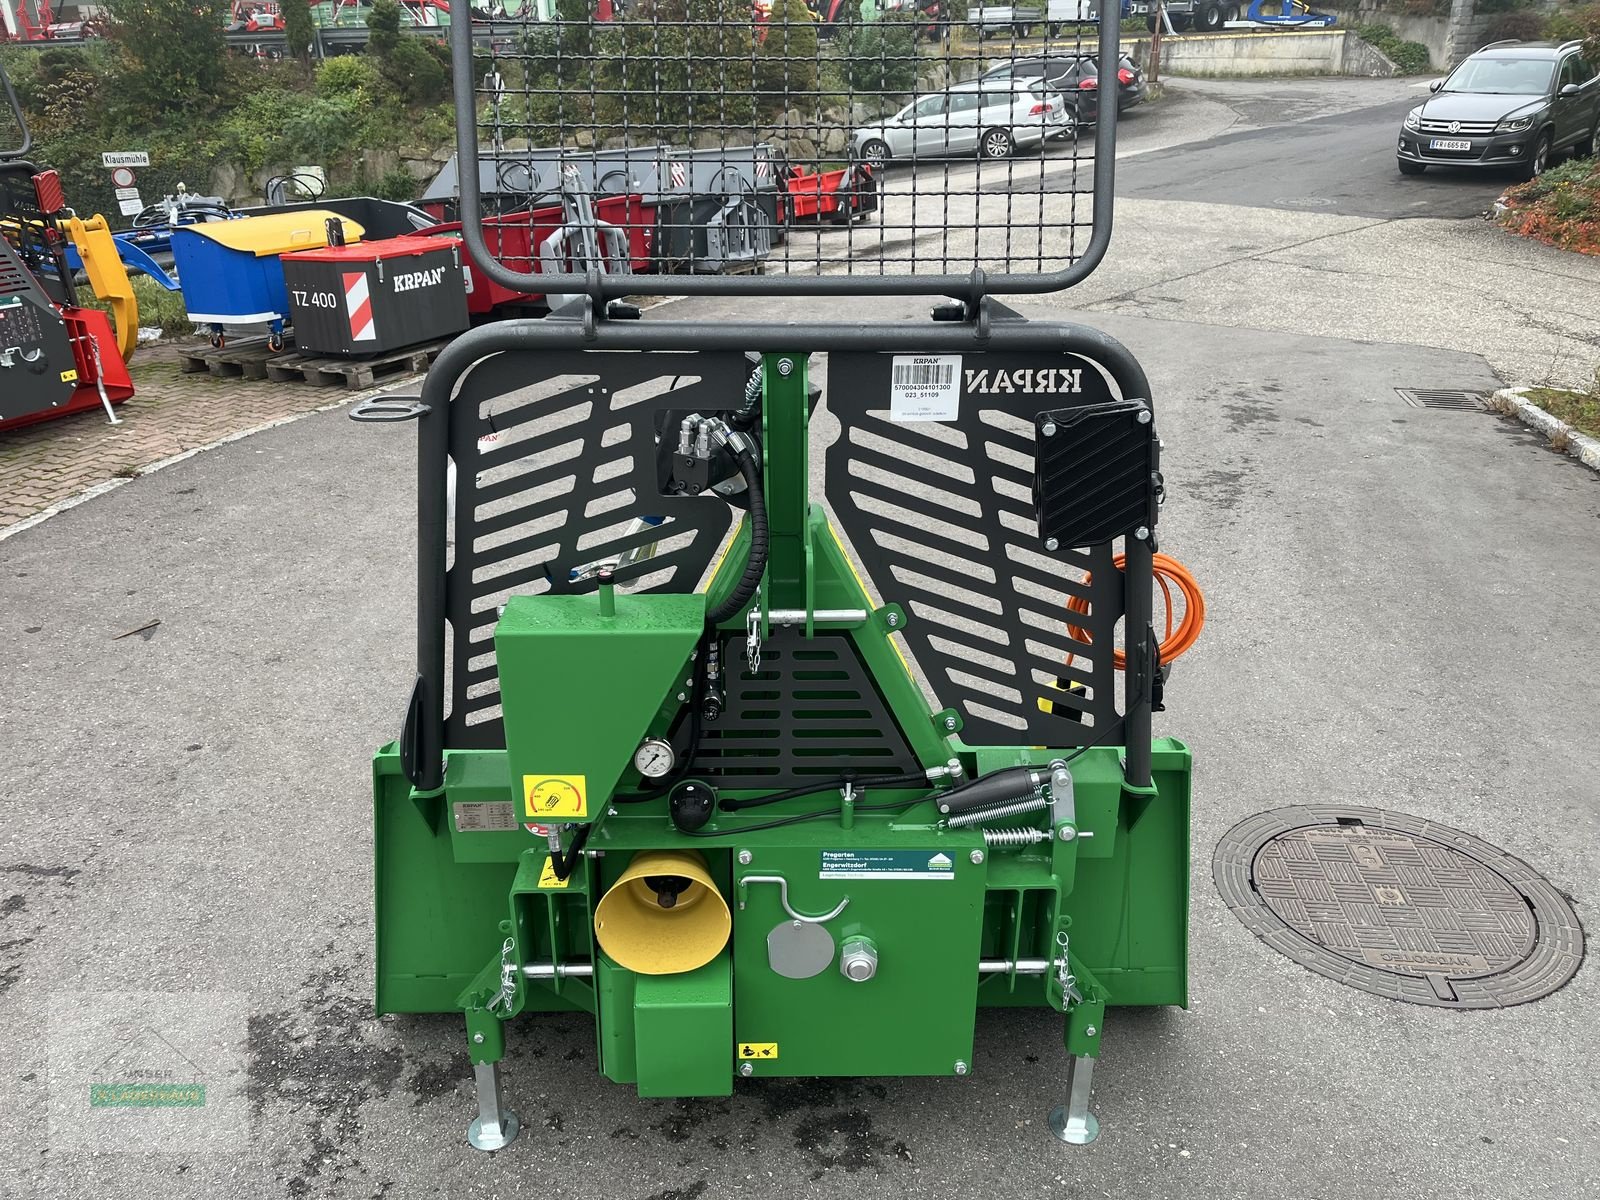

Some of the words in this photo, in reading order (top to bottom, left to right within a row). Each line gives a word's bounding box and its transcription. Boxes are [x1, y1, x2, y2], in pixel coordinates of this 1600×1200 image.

[104, 154, 147, 164] Klausmühle
[393, 267, 442, 293] KRPAN
[292, 290, 309, 307] TZ
[311, 292, 337, 309] 400
[480, 434, 498, 442] PAN
